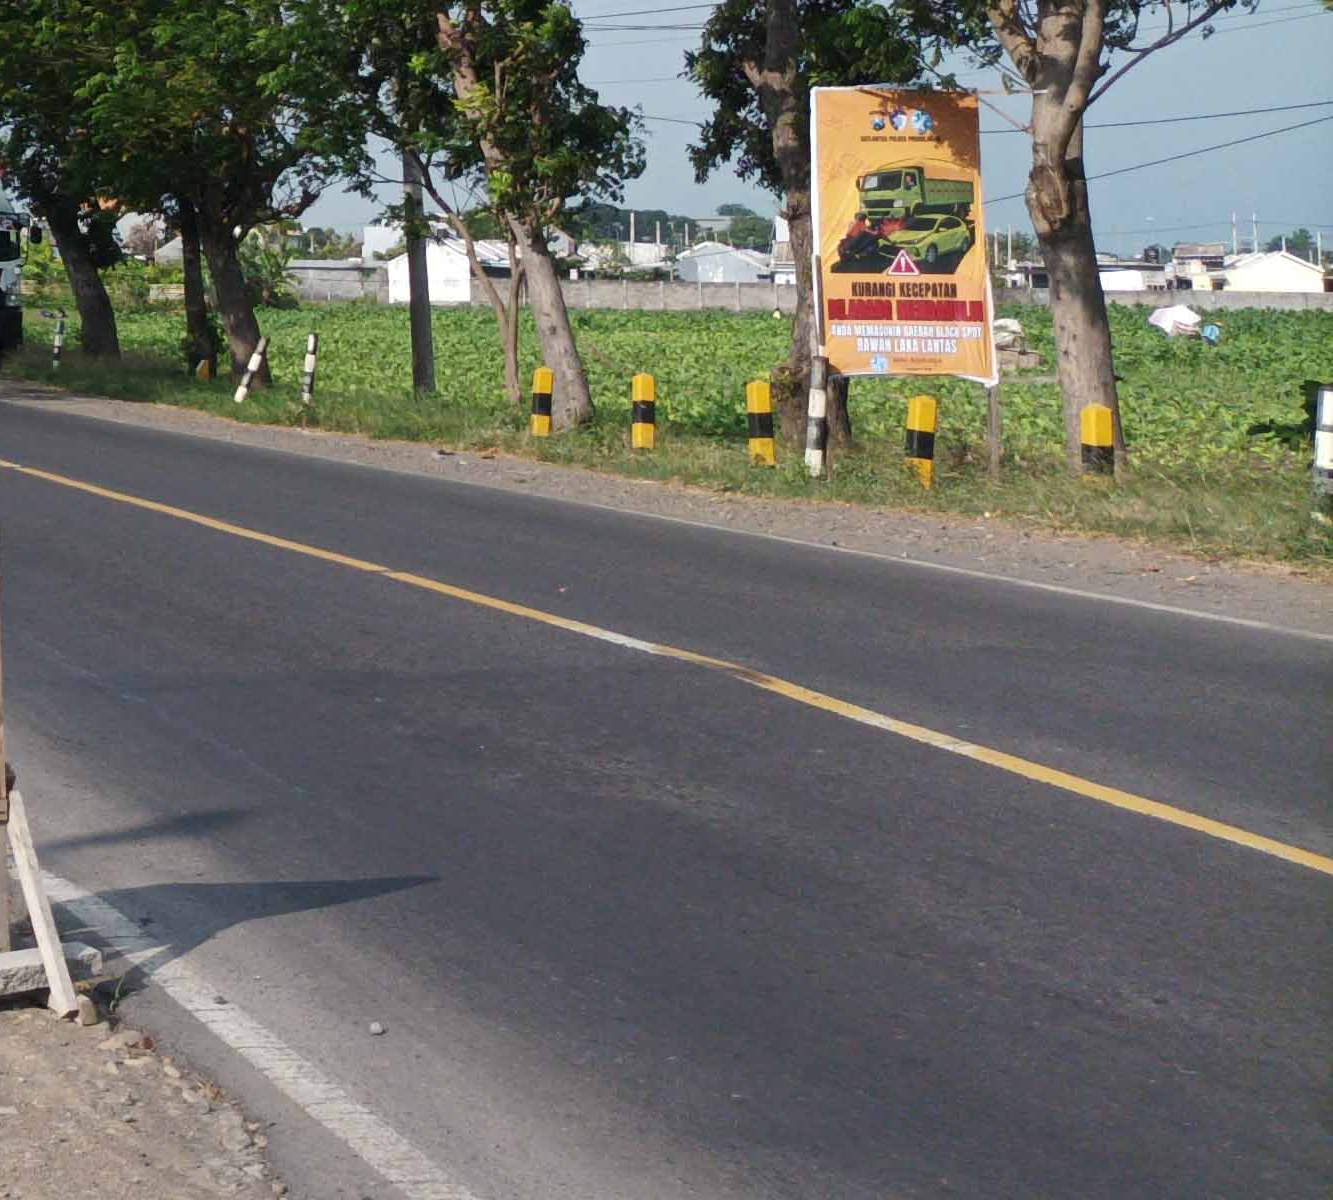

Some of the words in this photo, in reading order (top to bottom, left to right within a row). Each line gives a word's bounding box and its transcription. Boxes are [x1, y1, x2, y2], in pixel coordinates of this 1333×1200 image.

[851, 282, 896, 297] KURANGI
[899, 282, 957, 298] KECEPATAN
[857, 337, 891, 352] RAWAN
[894, 338, 918, 353] LAKA
[922, 338, 958, 353] LANTAS
